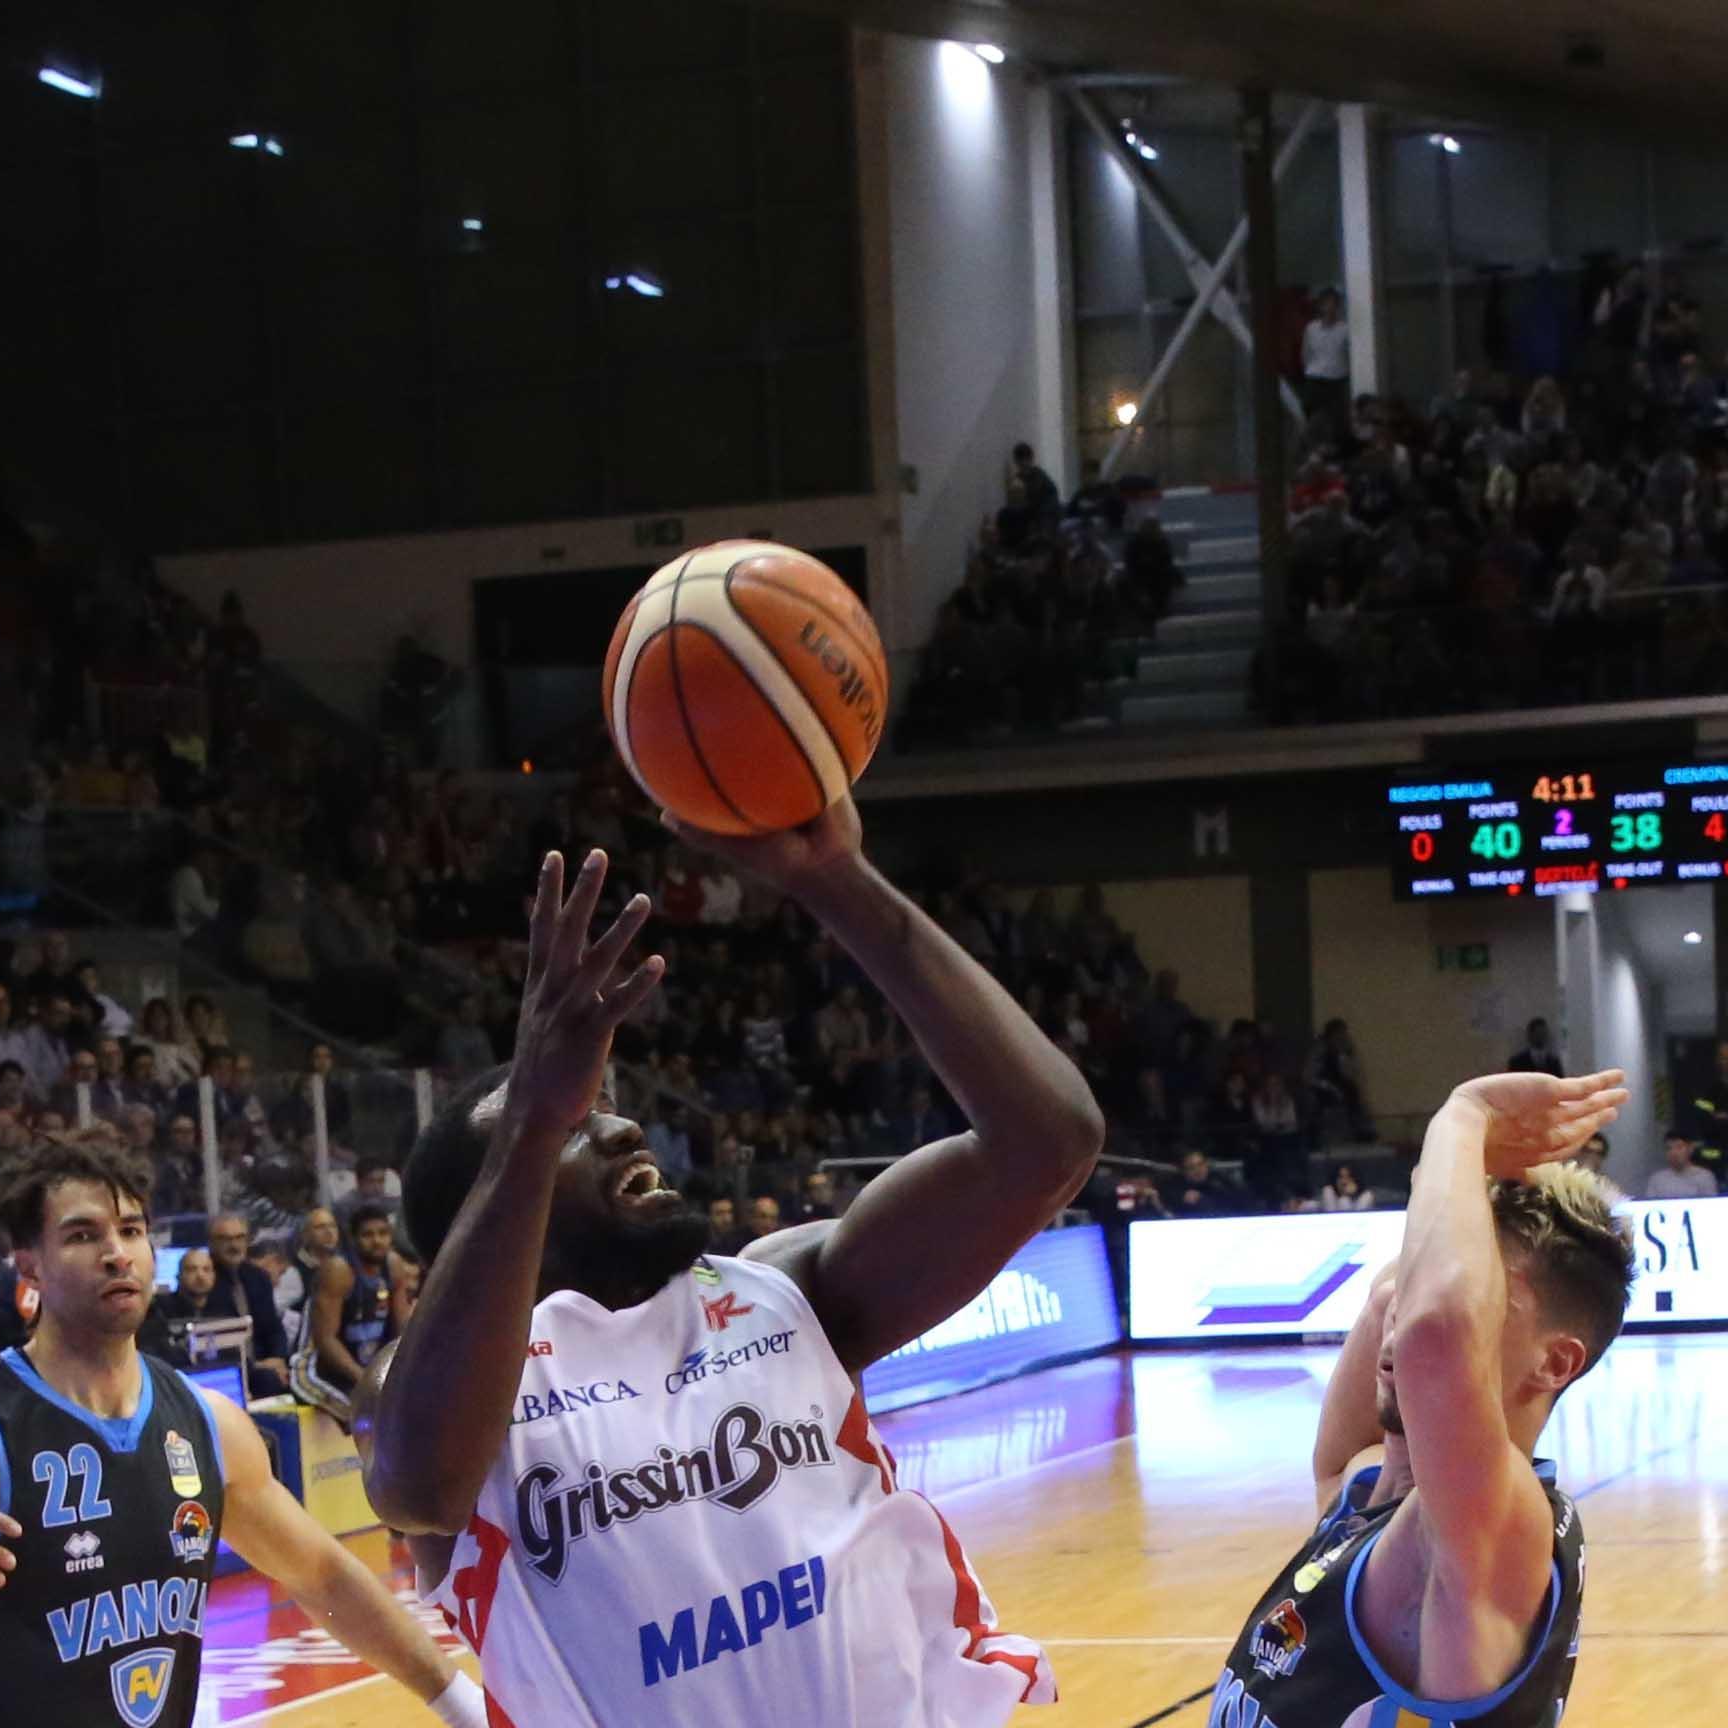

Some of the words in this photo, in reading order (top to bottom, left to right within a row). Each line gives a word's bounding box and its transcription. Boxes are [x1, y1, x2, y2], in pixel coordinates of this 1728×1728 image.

[1532, 772, 1595, 802] 4:11
[1614, 791, 1665, 809] POINTS
[1399, 814, 1443, 831] FOULS
[1468, 801, 1519, 819] POINTS
[1554, 808, 1574, 835] 2
[1471, 821, 1522, 860] 40
[1610, 812, 1663, 851] 38
[1703, 812, 1726, 842] 4
[1410, 830, 1435, 863] 0
[32, 1442, 112, 1529] 22
[515, 1402, 834, 1587] GrissinBon
[637, 1555, 826, 1687] MAPEI
